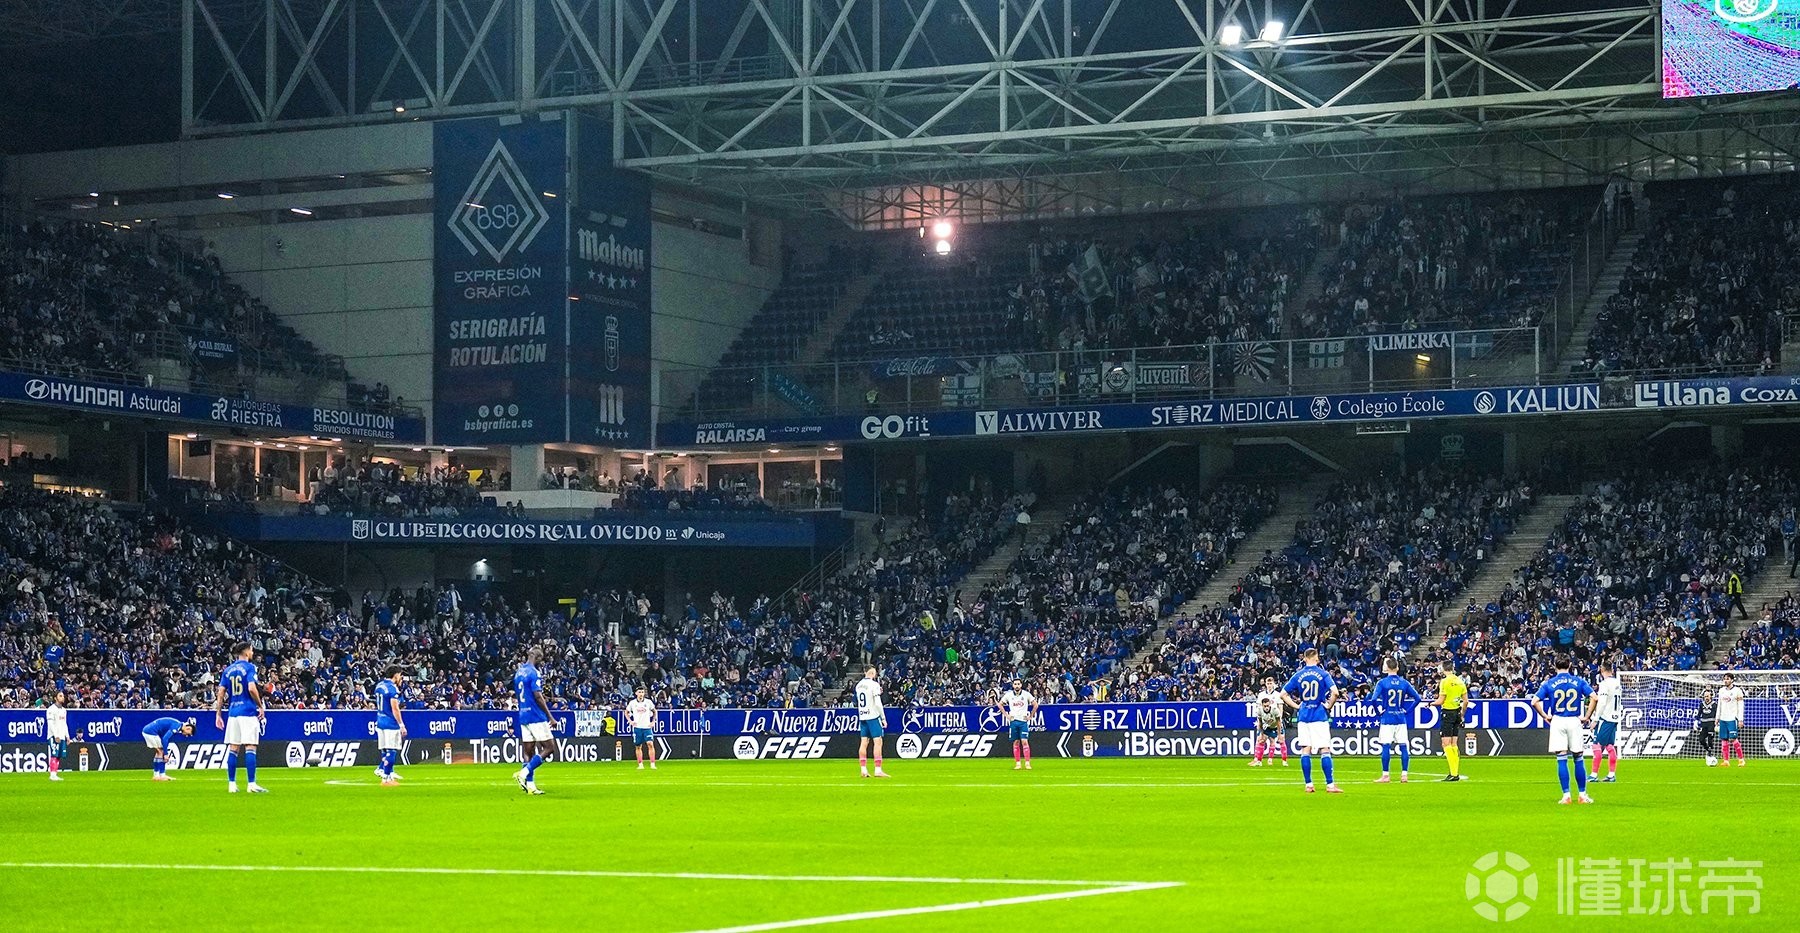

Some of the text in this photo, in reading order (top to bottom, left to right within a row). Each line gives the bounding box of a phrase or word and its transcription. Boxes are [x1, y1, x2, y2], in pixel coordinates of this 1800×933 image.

[477, 204, 519, 229] BSB
[578, 228, 645, 271] Mahou
[454, 262, 542, 283] EXPRESIÓN
[463, 283, 531, 300] GRÁFICA
[450, 312, 546, 340] SERIGRAFÍA
[1368, 333, 1451, 351] ALIMERKA
[451, 340, 547, 367] ROTULACIÓN
[51, 382, 181, 414] HYUNDAI Asturdai
[1507, 386, 1600, 413] KALIUN
[1664, 382, 1731, 406] llana
[232, 399, 282, 413] AUTORUEDAS
[1219, 400, 1299, 422] MEDICAL
[1337, 392, 1445, 418] Colegio École
[231, 409, 283, 427] RIESTRA
[314, 408, 394, 429] RESOLUTION
[464, 417, 534, 433] bsbgrafica.es
[314, 424, 394, 439] SERVICIOS INTEGRALES
[695, 428, 766, 444] RALARSA
[801, 425, 821, 433] group
[375, 522, 424, 538] CLUB
[540, 524, 587, 541] REAL
[590, 525, 661, 540] OVIEDO
[666, 528, 677, 540] BY
[696, 531, 725, 541] Unicaja
[229, 675, 243, 696] 16
[518, 681, 525, 703] 2
[1301, 680, 1319, 701] 20
[859, 692, 867, 708] 9
[1388, 689, 1402, 707] 21
[1554, 688, 1578, 712] 22
[670, 710, 711, 733] Colloo
[741, 710, 766, 733] La
[770, 710, 818, 733] Nueva
[924, 712, 967, 728] INTEGRA
[1137, 707, 1225, 730] MEDICAL
[1649, 708, 1684, 719] GRUPO
[289, 747, 301, 758] EA
[469, 738, 500, 764] The
[555, 738, 598, 762] Yours
[739, 741, 754, 750] EA
[901, 739, 917, 748] EA
